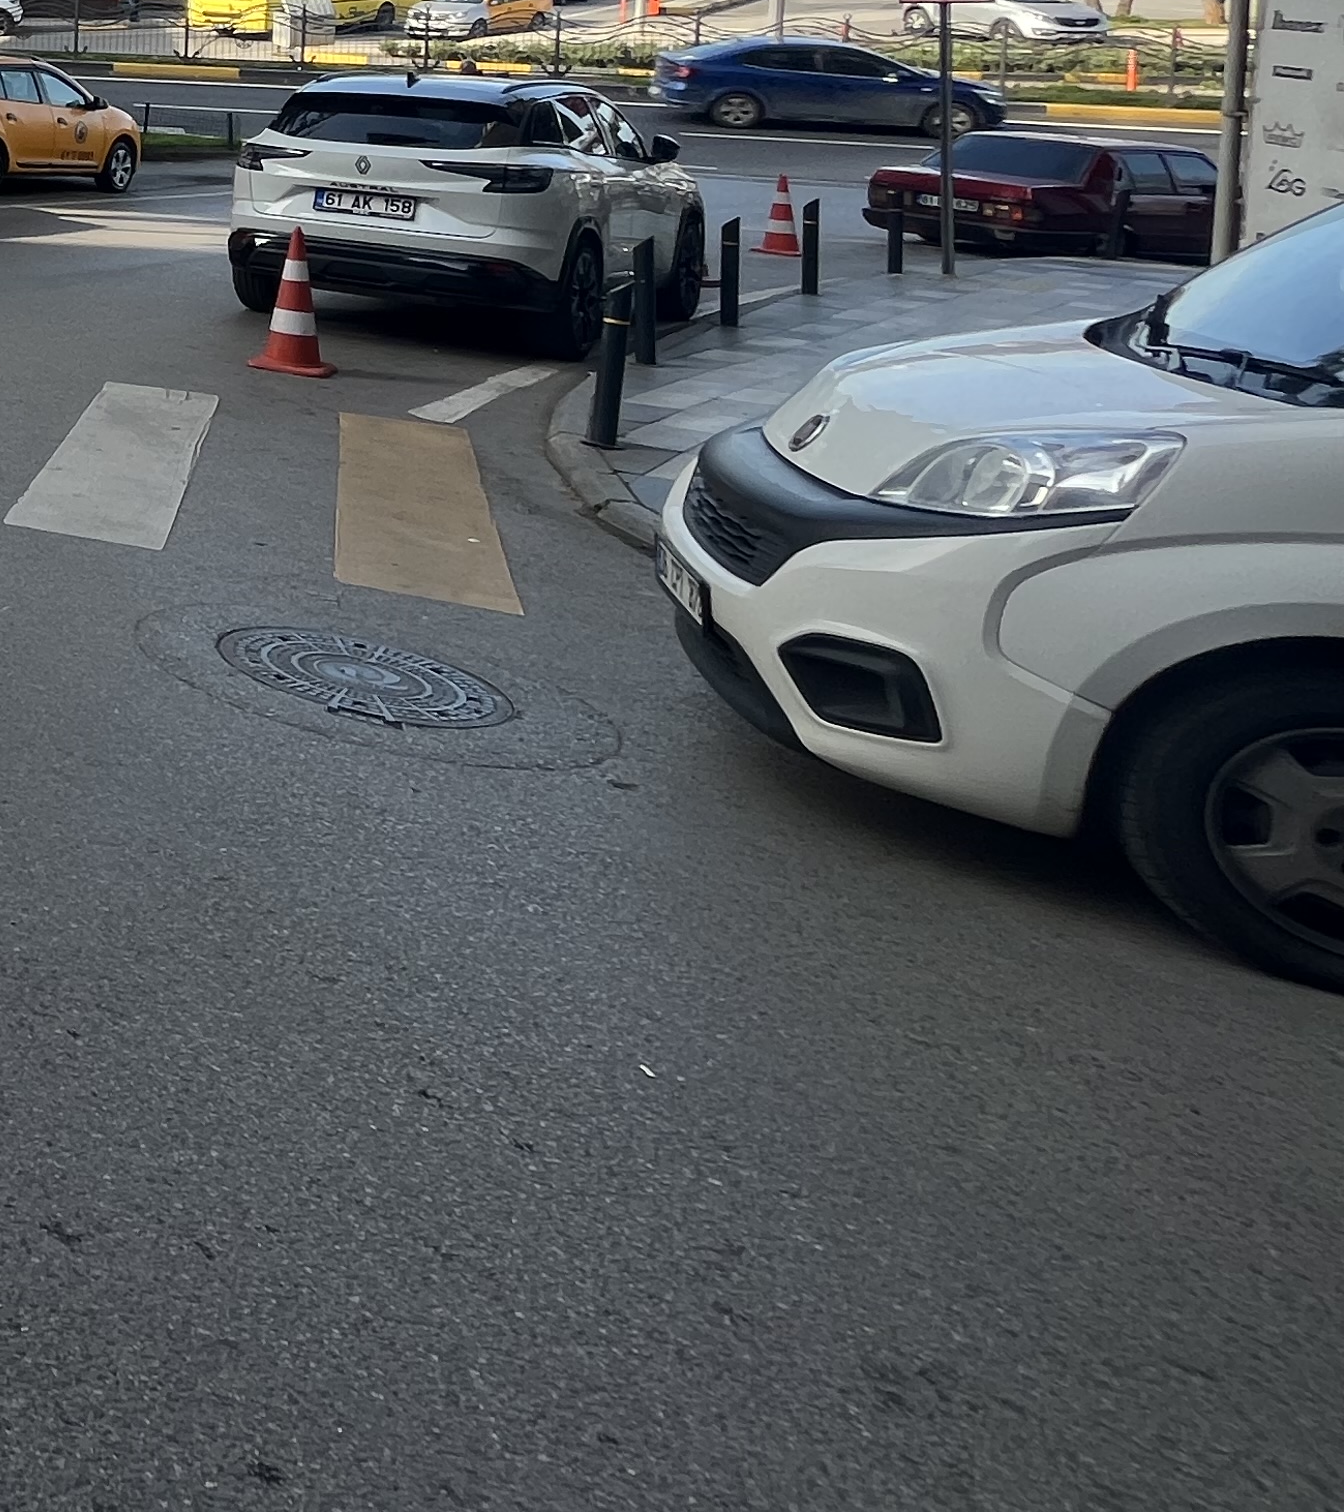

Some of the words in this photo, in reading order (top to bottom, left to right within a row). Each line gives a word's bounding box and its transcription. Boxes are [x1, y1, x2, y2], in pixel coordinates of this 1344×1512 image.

[330, 181, 398, 193] AUSTRAL
[325, 192, 343, 207] 61
[351, 195, 373, 211] AK
[384, 198, 413, 215] 158
